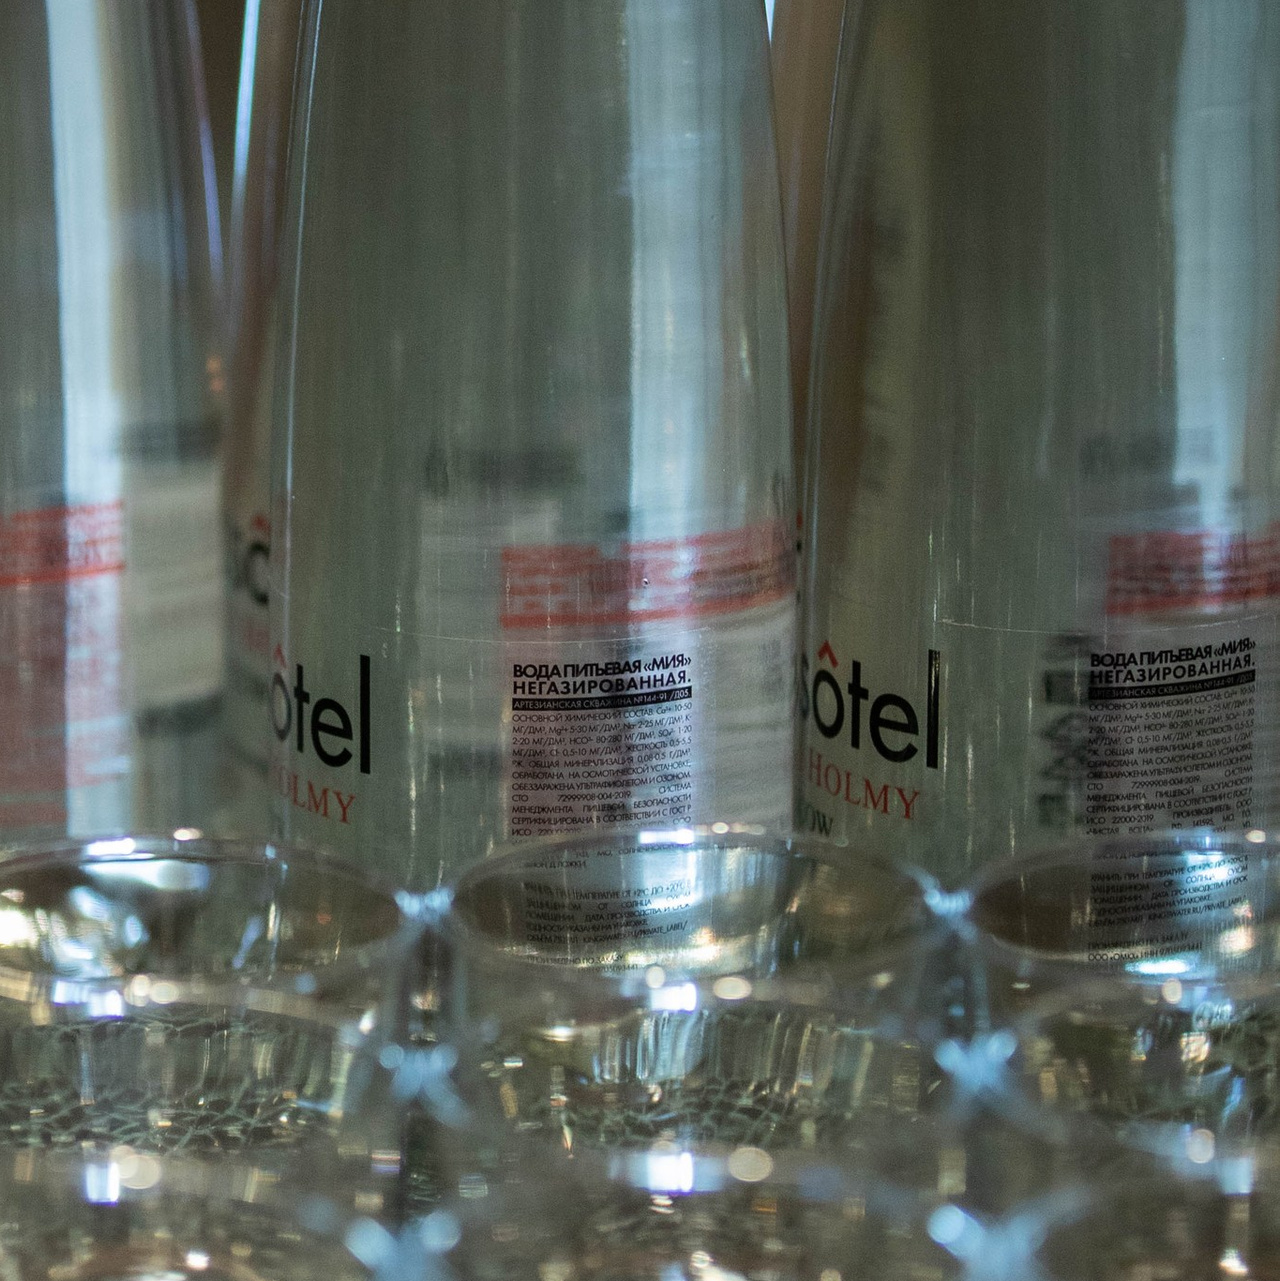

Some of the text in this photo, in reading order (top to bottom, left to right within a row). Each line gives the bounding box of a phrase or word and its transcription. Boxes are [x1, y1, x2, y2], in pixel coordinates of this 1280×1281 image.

[513, 654, 691, 680] ВОДА ПИТЬЕВАЯ «МИЯ»
[1091, 637, 1255, 669] ВОДА ПИТЬЕВАЯ «МИЯ»
[513, 670, 691, 695] НЕГАЗИРОВАННАЯ.
[1090, 654, 1255, 684] НЕГАЗИРОВАННАЯ.
